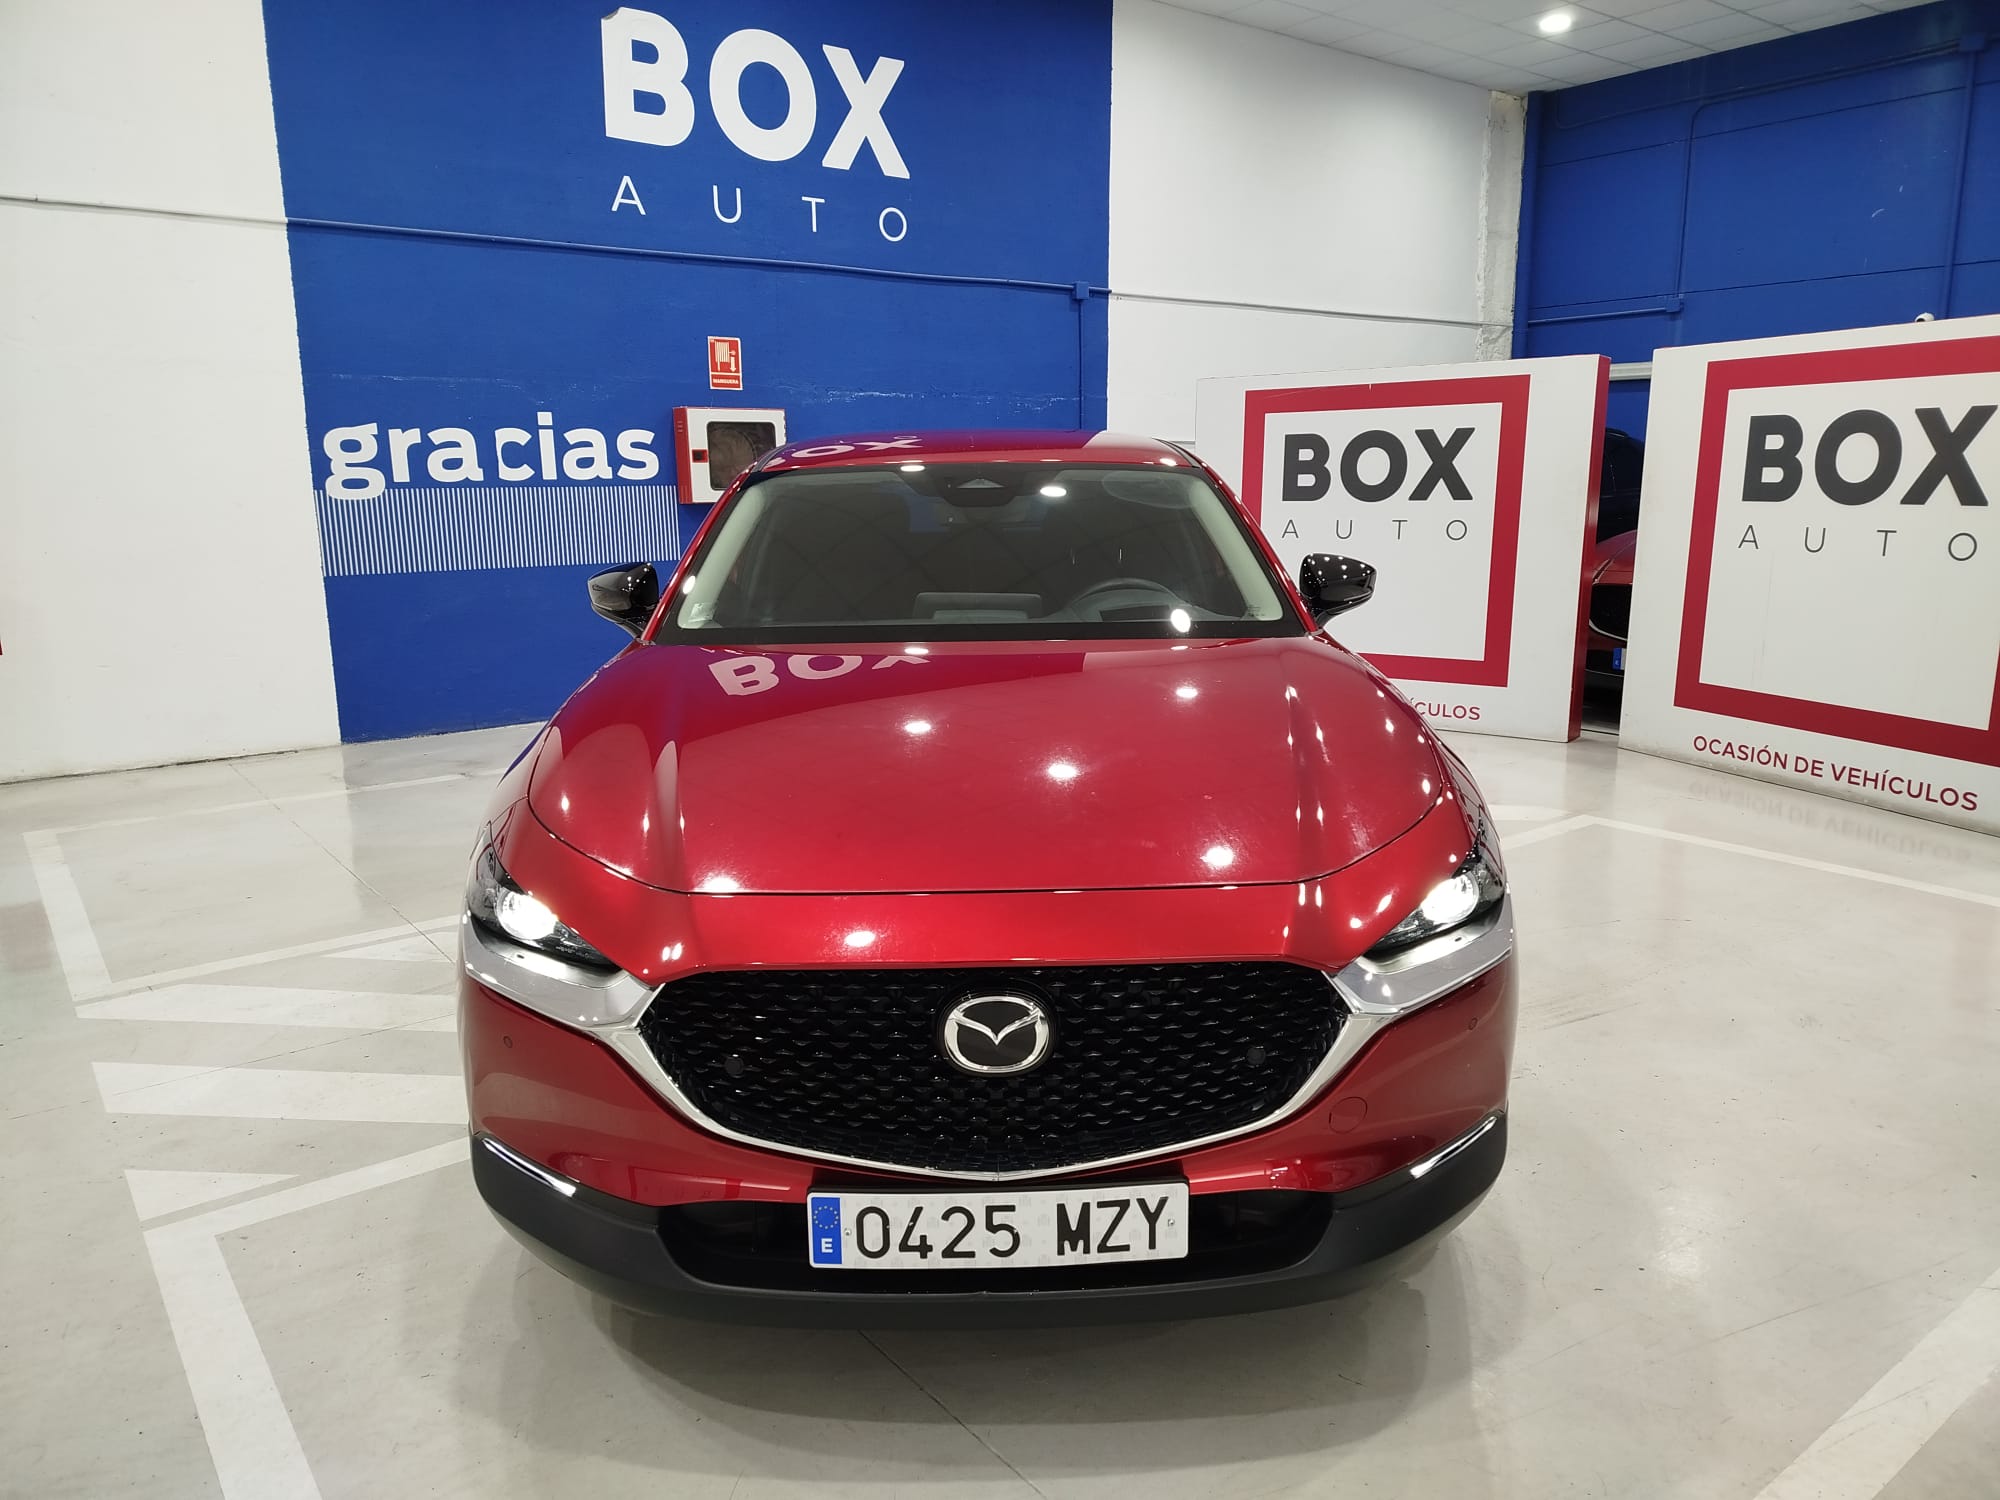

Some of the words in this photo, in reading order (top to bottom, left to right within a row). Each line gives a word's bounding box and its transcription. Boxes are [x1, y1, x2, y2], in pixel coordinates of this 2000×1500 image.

[601, 7, 910, 180] BOX
[611, 175, 908, 242] AUTO
[323, 411, 660, 500] gracias
[1282, 427, 1476, 503] BOX
[1741, 405, 1998, 506] BOX
[1281, 519, 1468, 541] AUTO
[1737, 524, 1977, 562] AUTO
[1693, 735, 1788, 770] OCASIÓN
[1794, 755, 1825, 778] DE
[1831, 763, 1979, 811] VEHÍCULOS
[820, 1238, 834, 1253] E
[855, 1205, 1021, 1259] 0425
[1056, 1196, 1169, 1257] MZY
